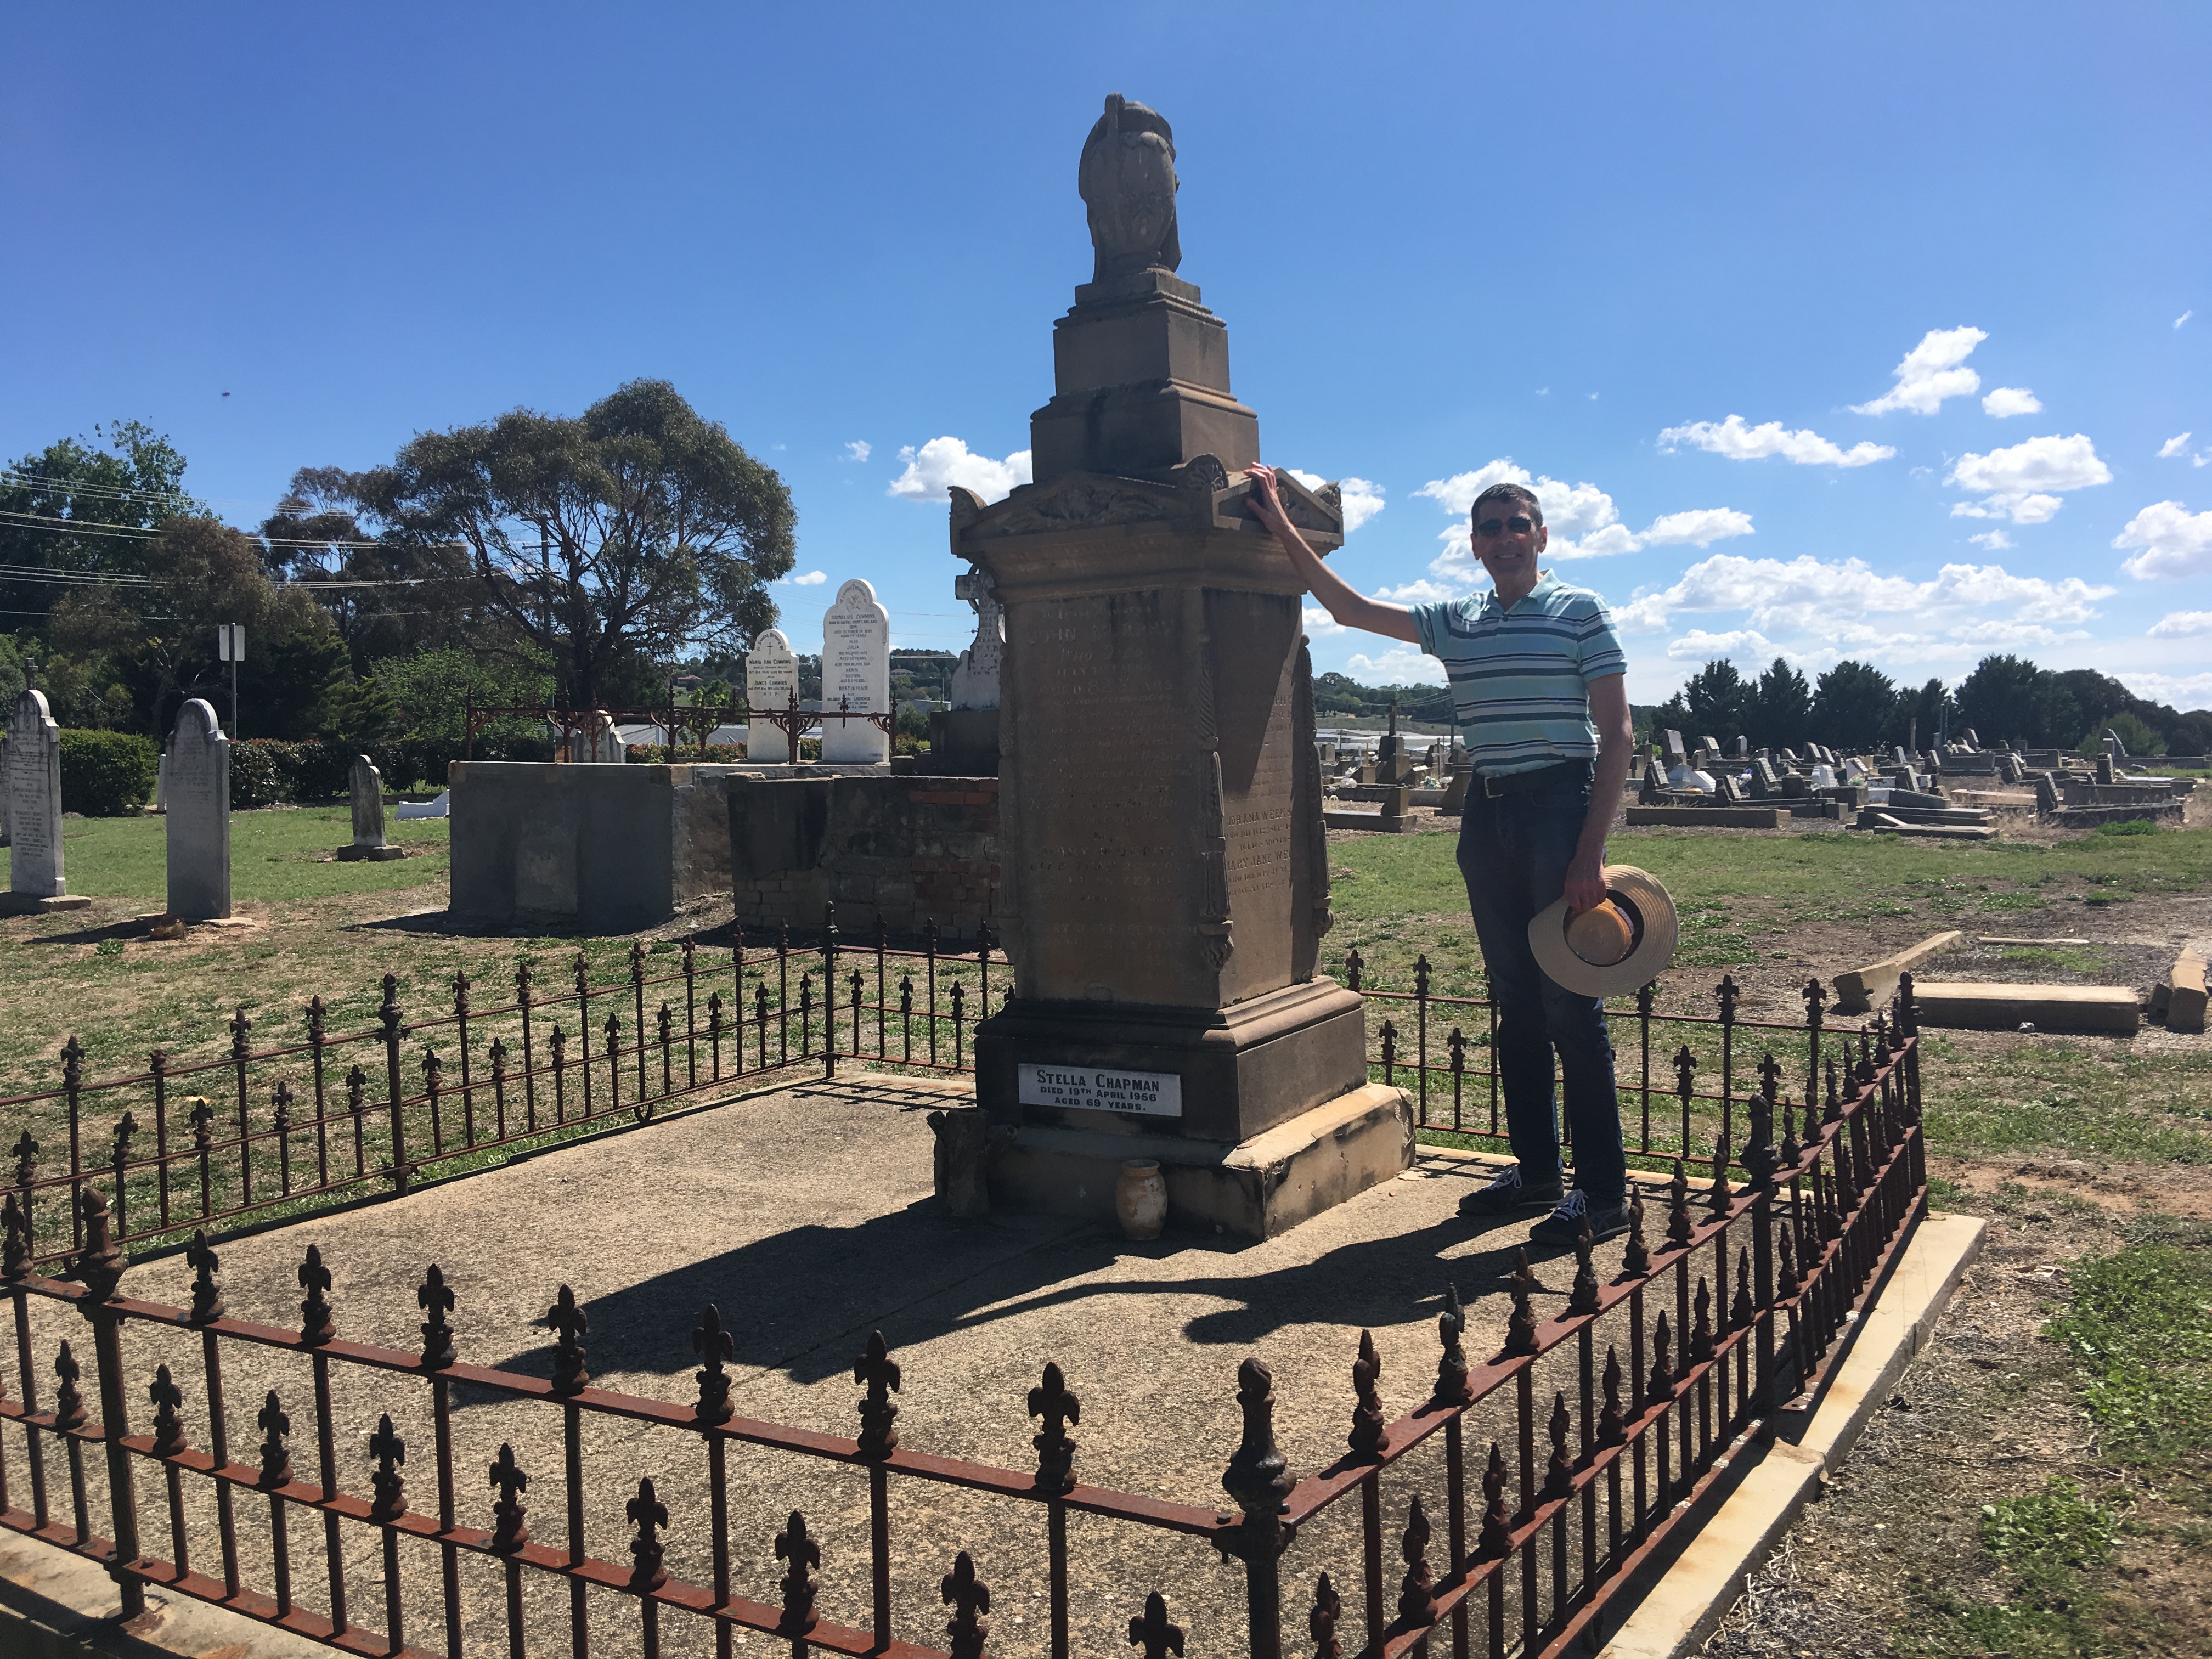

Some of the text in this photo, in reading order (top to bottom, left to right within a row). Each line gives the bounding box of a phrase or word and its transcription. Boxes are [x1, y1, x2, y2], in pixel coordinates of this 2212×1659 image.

[1040, 1086, 1063, 1094] DIED
[1096, 1090, 1126, 1099] APRIL
[1130, 1092, 1157, 1102] 1956
[1055, 1097, 1146, 1111] AGED 69 YEARS.
